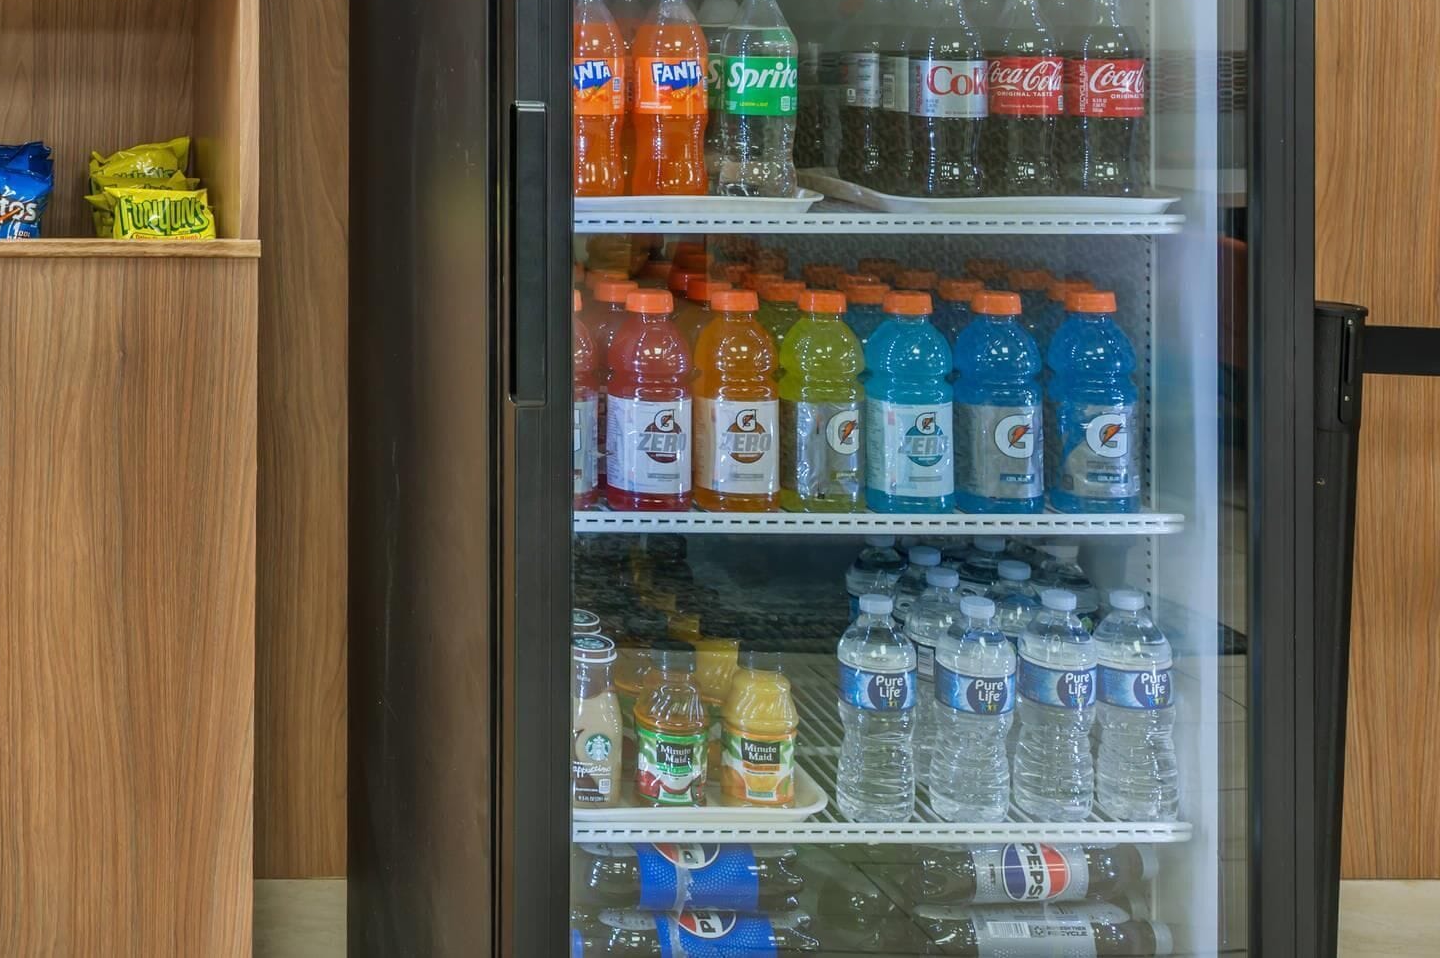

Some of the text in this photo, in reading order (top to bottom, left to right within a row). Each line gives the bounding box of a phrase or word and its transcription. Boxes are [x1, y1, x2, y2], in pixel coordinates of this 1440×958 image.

[574, 60, 611, 80] ANTA
[654, 60, 703, 82] FANTA
[727, 62, 797, 94] Sprite
[1089, 62, 1145, 94] Coca-C
[926, 65, 988, 97] Cok
[119, 195, 210, 237] Funyuns
[637, 433, 687, 451] ZERO
[719, 433, 772, 451] ZERO
[898, 435, 947, 454] ER
[875, 675, 904, 687] Pure
[975, 679, 1004, 691] Pure
[1065, 672, 1090, 684] Pure
[1141, 672, 1167, 684] Pure
[879, 685, 901, 702] Life
[978, 690, 1001, 706] Life
[1068, 682, 1089, 699] Life
[1144, 682, 1166, 699] Life
[660, 744, 692, 756] Minute
[744, 741, 777, 753] Minute
[665, 752, 687, 763] Maid
[748, 751, 772, 761] Maid
[1021, 842, 1044, 900] PEPSI
